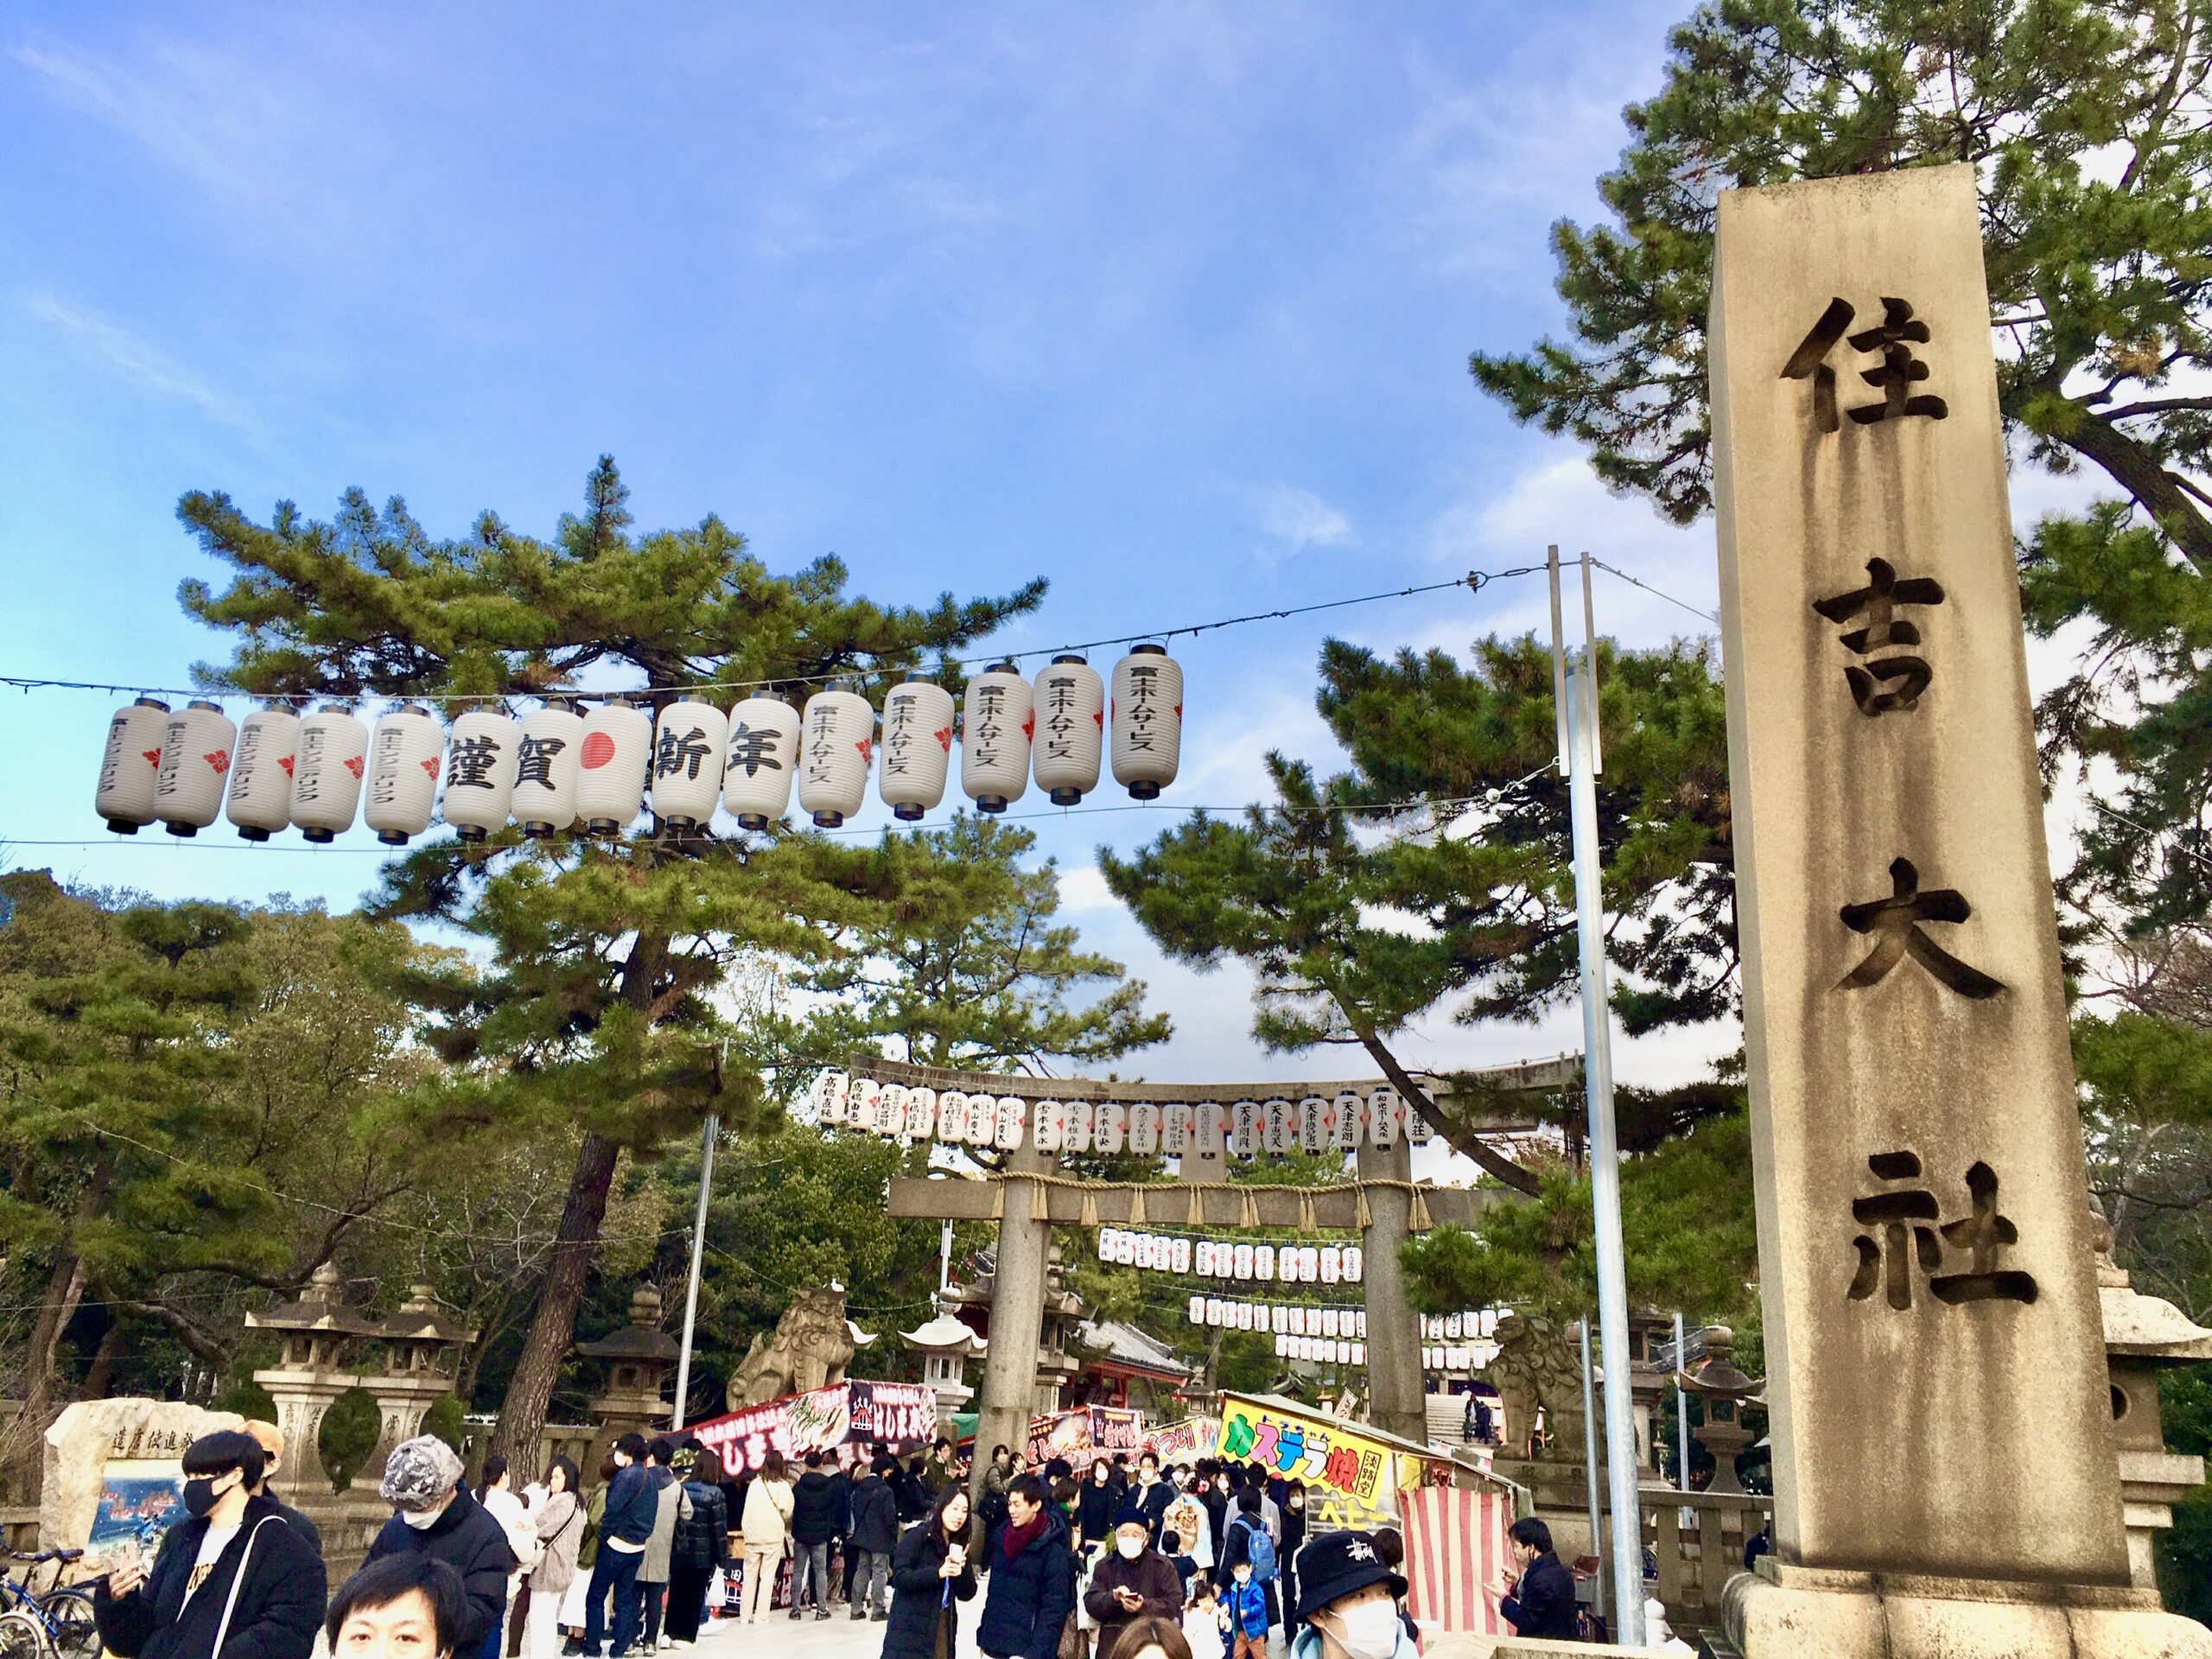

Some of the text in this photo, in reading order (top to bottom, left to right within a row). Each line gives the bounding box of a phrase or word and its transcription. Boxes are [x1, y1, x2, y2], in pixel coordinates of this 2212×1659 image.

[809, 706, 839, 784] 富士ホームサービス
[887, 695, 918, 775] 富士ホームサービス
[975, 686, 1007, 767] 富士ホームサービス
[1046, 677, 1077, 759] 富士ホームサービス
[1129, 666, 1159, 751] 富士ホームサービス
[1780, 296, 2037, 1312] 住吉大社
[705, 1426, 793, 1476] しまき
[1224, 1414, 1359, 1493] カステラ焼
[1357, 1454, 1378, 1495] 淡路堂
